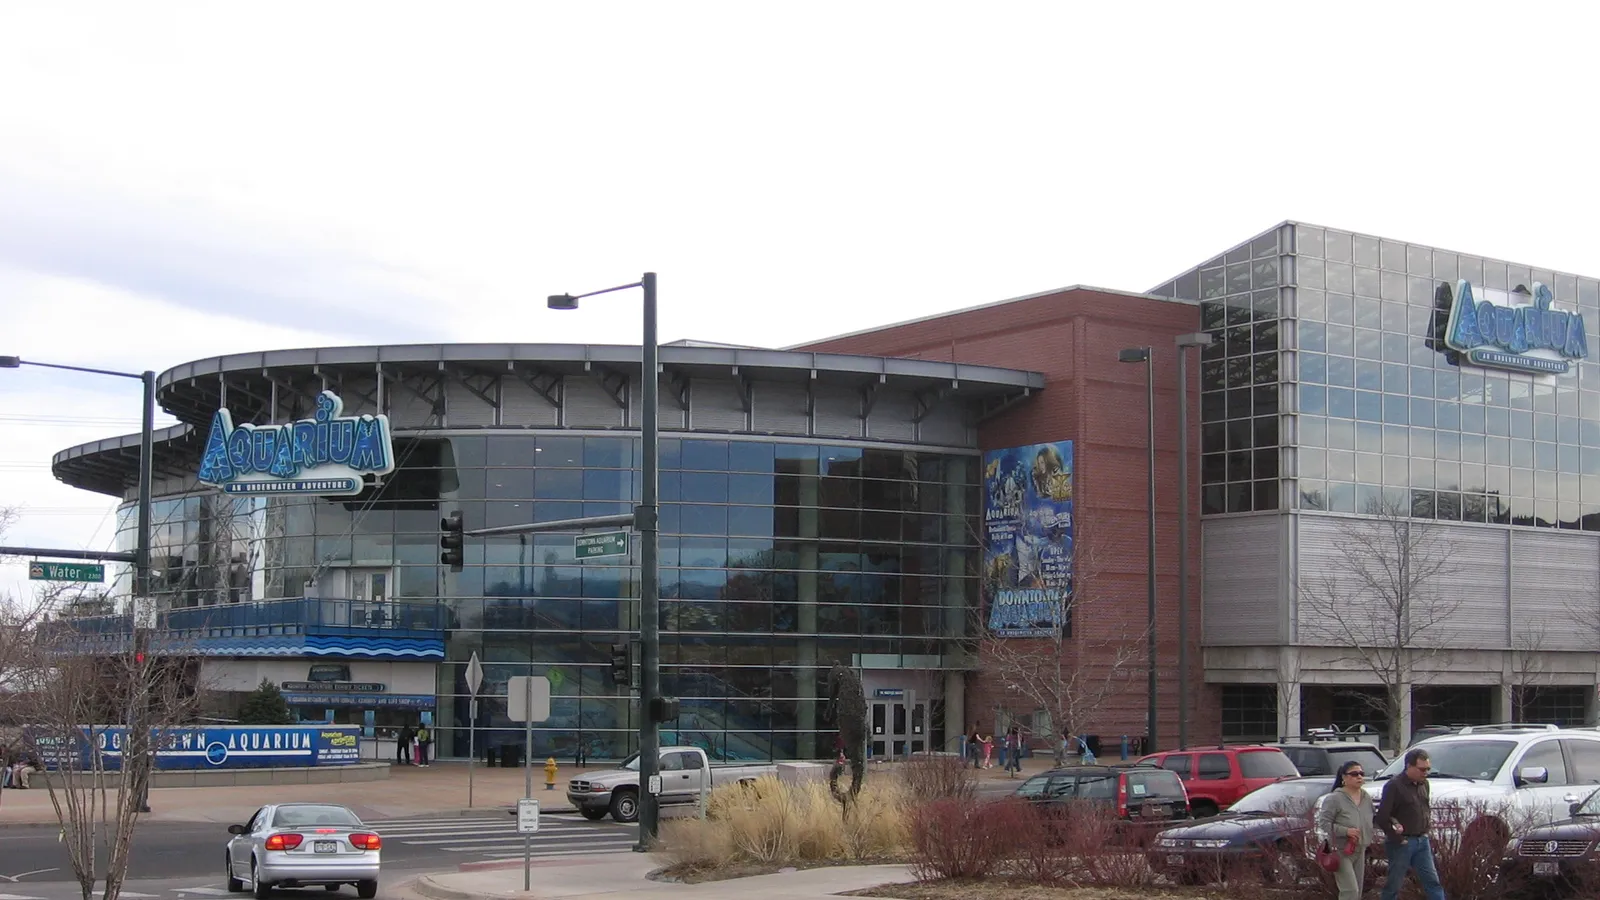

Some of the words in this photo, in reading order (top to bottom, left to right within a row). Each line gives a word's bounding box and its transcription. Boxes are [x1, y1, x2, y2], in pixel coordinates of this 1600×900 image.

[1494, 354, 1530, 365] UNDERWATER
[1533, 360, 1564, 371] ADVENTURE
[246, 482, 297, 491] UNDERWATER
[301, 481, 347, 490] ADVENTURE
[49, 565, 81, 578] Water
[228, 733, 311, 751] AQUARIUM
